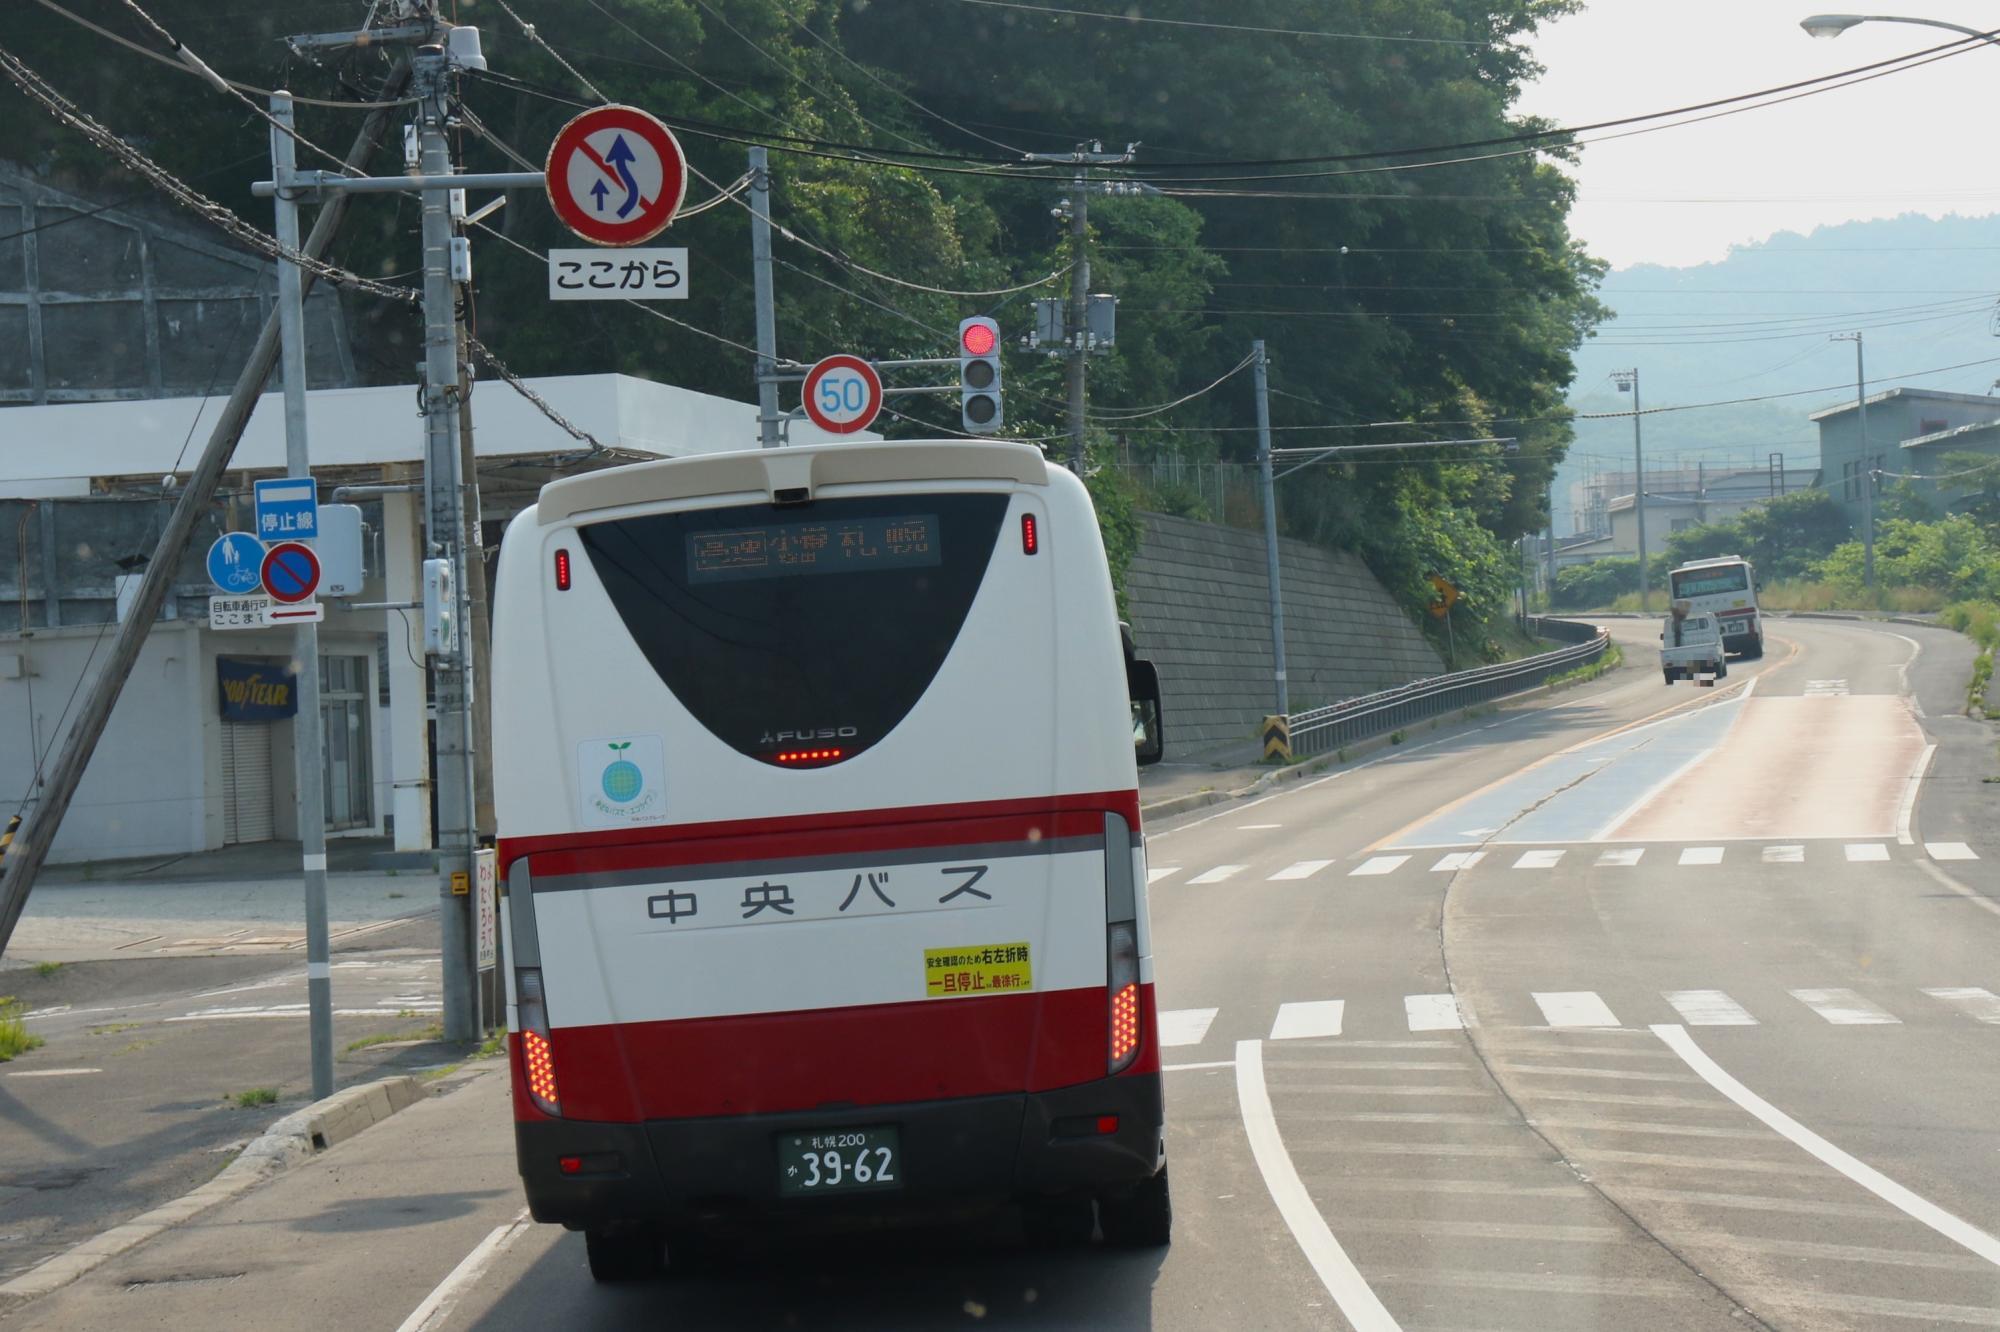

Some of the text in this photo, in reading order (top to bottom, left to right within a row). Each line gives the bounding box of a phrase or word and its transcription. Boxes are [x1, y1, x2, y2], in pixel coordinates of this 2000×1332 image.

[557, 259, 681, 290] ここから
[820, 377, 865, 413] 50
[261, 511, 314, 532] 停止線
[776, 726, 858, 742] FUSO
[647, 864, 992, 925] 中央バス
[786, 1147, 894, 1187] か 39-62
